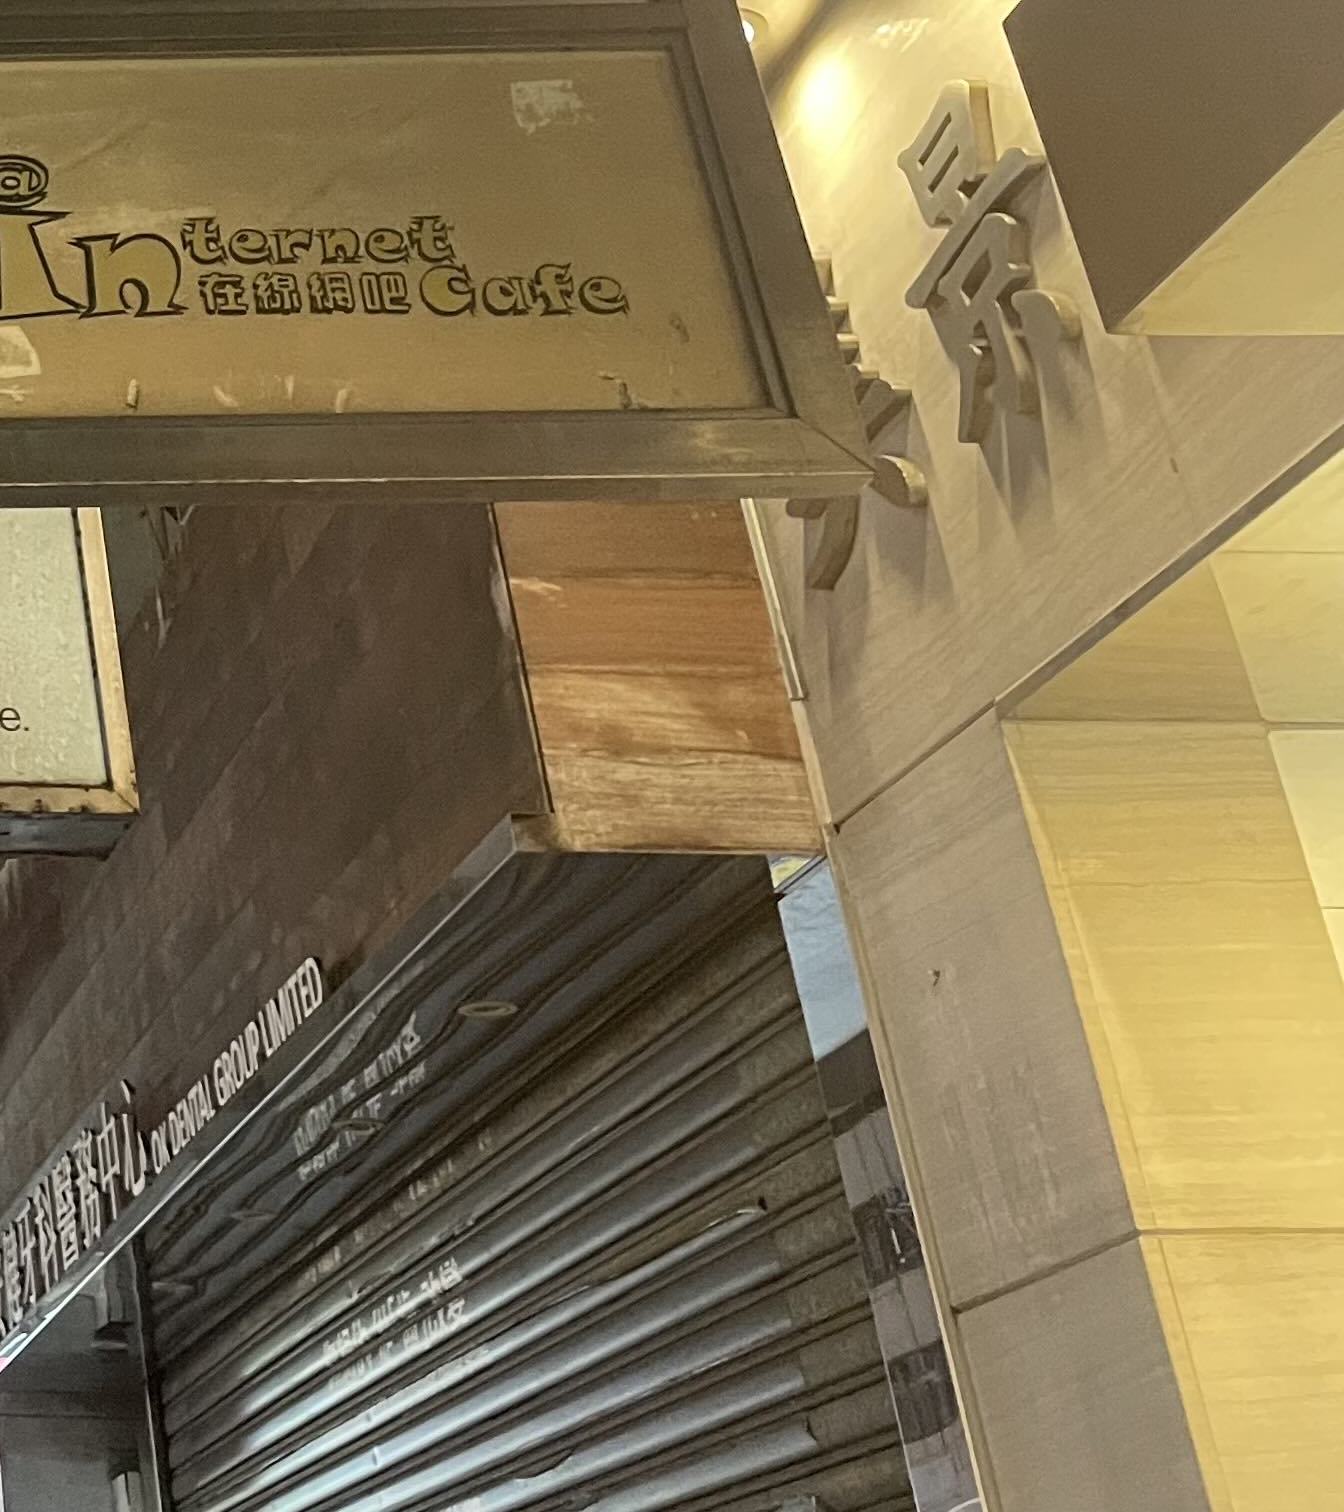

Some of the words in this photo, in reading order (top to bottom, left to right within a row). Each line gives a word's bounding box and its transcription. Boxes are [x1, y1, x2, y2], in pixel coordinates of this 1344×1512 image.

[151, 1120, 171, 1175] OK
[168, 1074, 216, 1156] DENTAL
[213, 1021, 260, 1106] GROUP
[257, 957, 323, 1058] LIMITED
